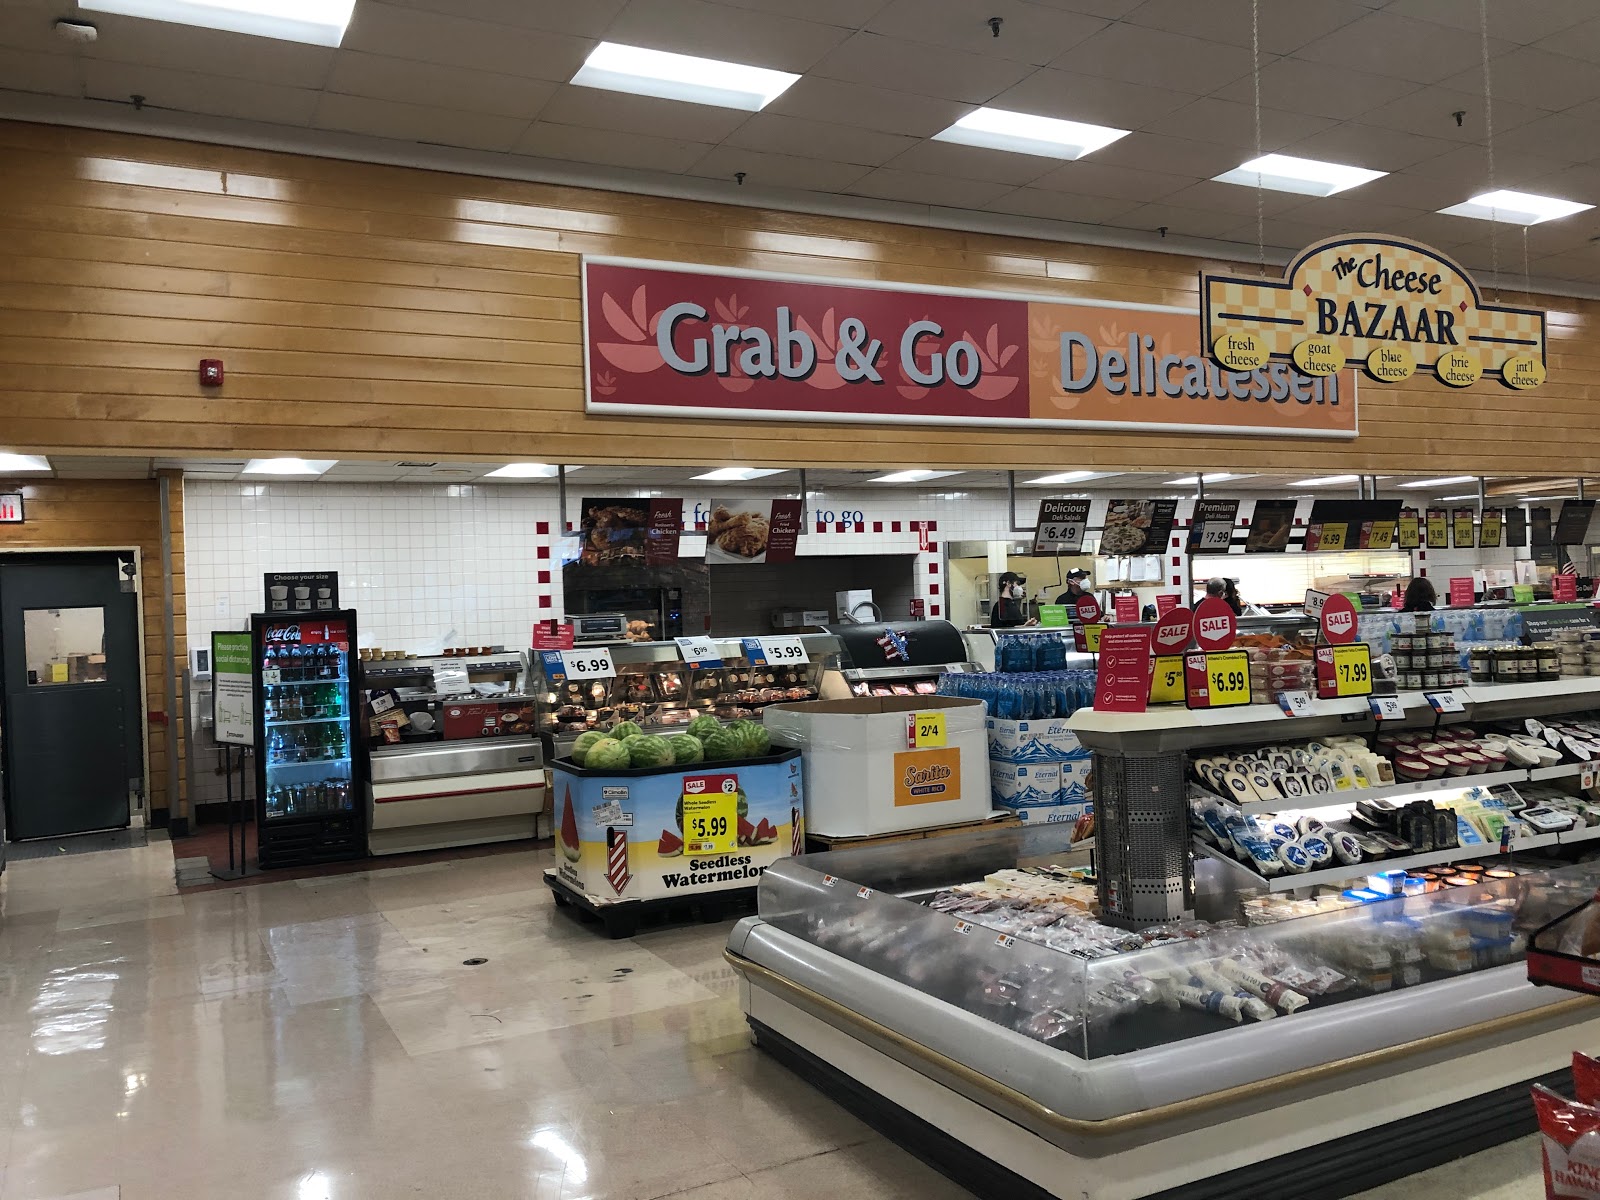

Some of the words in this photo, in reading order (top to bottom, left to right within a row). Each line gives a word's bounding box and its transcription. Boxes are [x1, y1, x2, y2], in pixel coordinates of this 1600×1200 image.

[1332, 257, 1358, 280] The
[1357, 253, 1442, 295] Cheese
[1316, 298, 1459, 345] BAZAAR
[656, 302, 816, 381] Grab
[835, 318, 885, 384] &
[900, 320, 983, 388] Go
[1228, 336, 1255, 351] fresh
[1308, 344, 1331, 356] goat
[1381, 349, 1402, 363] blue
[1224, 351, 1260, 366] cheese
[1303, 357, 1337, 372] cheese
[1451, 355, 1469, 368] brie
[1377, 364, 1408, 377] cheese
[1516, 360, 1533, 372] int'l
[1446, 370, 1475, 382] cheese
[1511, 373, 1539, 386] cheese
[1044, 503, 1087, 513] Delicious
[1199, 503, 1236, 512] Premium
[816, 509, 835, 524] to
[841, 511, 864, 528] go
[1044, 527, 1076, 539] $6.49
[1206, 532, 1229, 543] $7.99
[1202, 619, 1228, 632] SALE
[1328, 613, 1350, 626] SALE
[1160, 626, 1187, 638] SALE
[217, 642, 232, 651] Please
[232, 643, 248, 652] practice
[769, 646, 803, 659] $5.99
[1319, 649, 1332, 657] SALE
[216, 655, 229, 663] social
[1188, 656, 1205, 664] SALE
[570, 659, 609, 672] $6.99
[1340, 663, 1367, 682] $7.99
[1212, 672, 1244, 692] $6.99
[999, 726, 1016, 735] Eternal
[1047, 726, 1075, 735] Etern
[904, 764, 951, 788] Sarita
[993, 769, 1016, 781] Eternal
[1034, 770, 1058, 779] Eternal
[687, 781, 704, 789] SALE
[724, 783, 733, 792] $2
[913, 786, 930, 794] WHITE
[1047, 811, 1081, 823] Eternal
[692, 817, 727, 837] $5.99
[689, 855, 752, 871] Seedless
